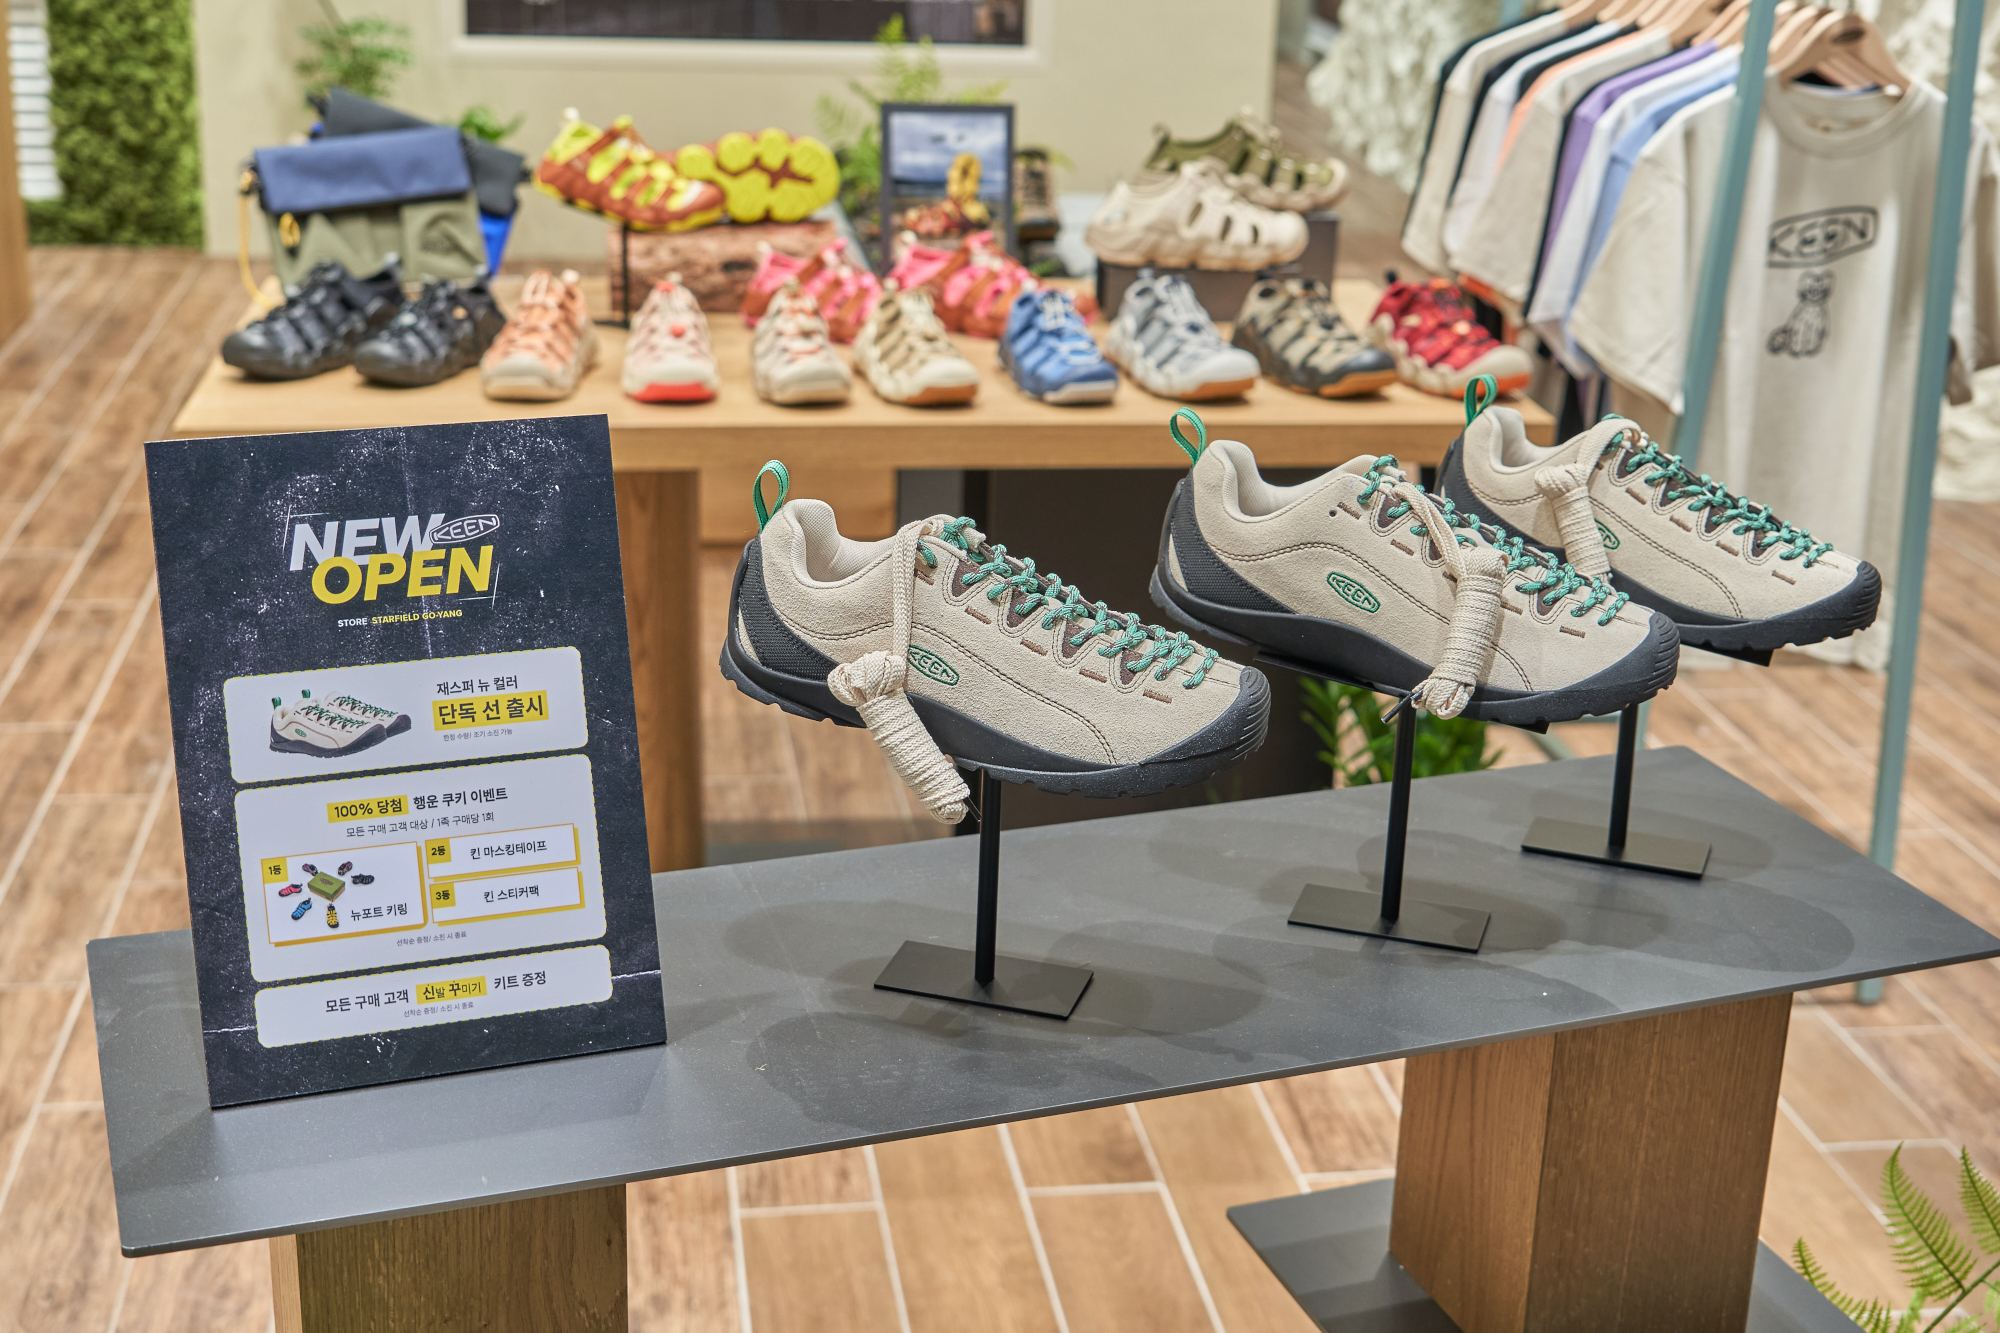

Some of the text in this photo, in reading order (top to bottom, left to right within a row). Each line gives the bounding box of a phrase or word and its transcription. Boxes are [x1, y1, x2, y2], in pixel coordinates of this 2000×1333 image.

[1769, 216, 1869, 258] KEEN
[433, 517, 497, 541] KEEN
[290, 513, 445, 571] NEW
[312, 545, 493, 604] OPEN
[1332, 576, 1376, 608] KEEN
[338, 609, 463, 627] STORE STARFIELD GO-YANG
[908, 648, 955, 681] KEEN
[437, 675, 518, 695] 재스퍼 뉴 컬러
[439, 695, 543, 725] 단독 선 출시
[443, 733, 456, 741] 한정
[474, 730, 485, 738] 조기
[487, 729, 499, 737] 소진
[501, 728, 513, 736] 가능
[334, 788, 508, 818] 100% 당첨 행운 쿠키 이벤트
[346, 826, 365, 838] 모든
[367, 823, 387, 836] 구매
[389, 821, 408, 833] 고객
[410, 818, 429, 830] 대상
[437, 816, 450, 827] 1족
[452, 813, 480, 826] 구매당
[482, 811, 494, 822] 1회
[431, 846, 446, 856] 2등
[470, 840, 547, 860] 킨 마스킹테이프
[268, 865, 282, 875] 1등
[435, 890, 450, 900] 3등
[484, 885, 540, 903] 킨 스티커팩
[351, 903, 407, 921] 뉴포트 키링
[433, 933, 445, 941] 소진
[447, 932, 453, 940] 시
[454, 931, 467, 939] 종료
[325, 970, 547, 1013] 모든 구매 고객 신발 꾸미기 키트 증정
[440, 1004, 452, 1012] 소진
[454, 1003, 460, 1011] 시
[461, 1001, 474, 1010] 종료
